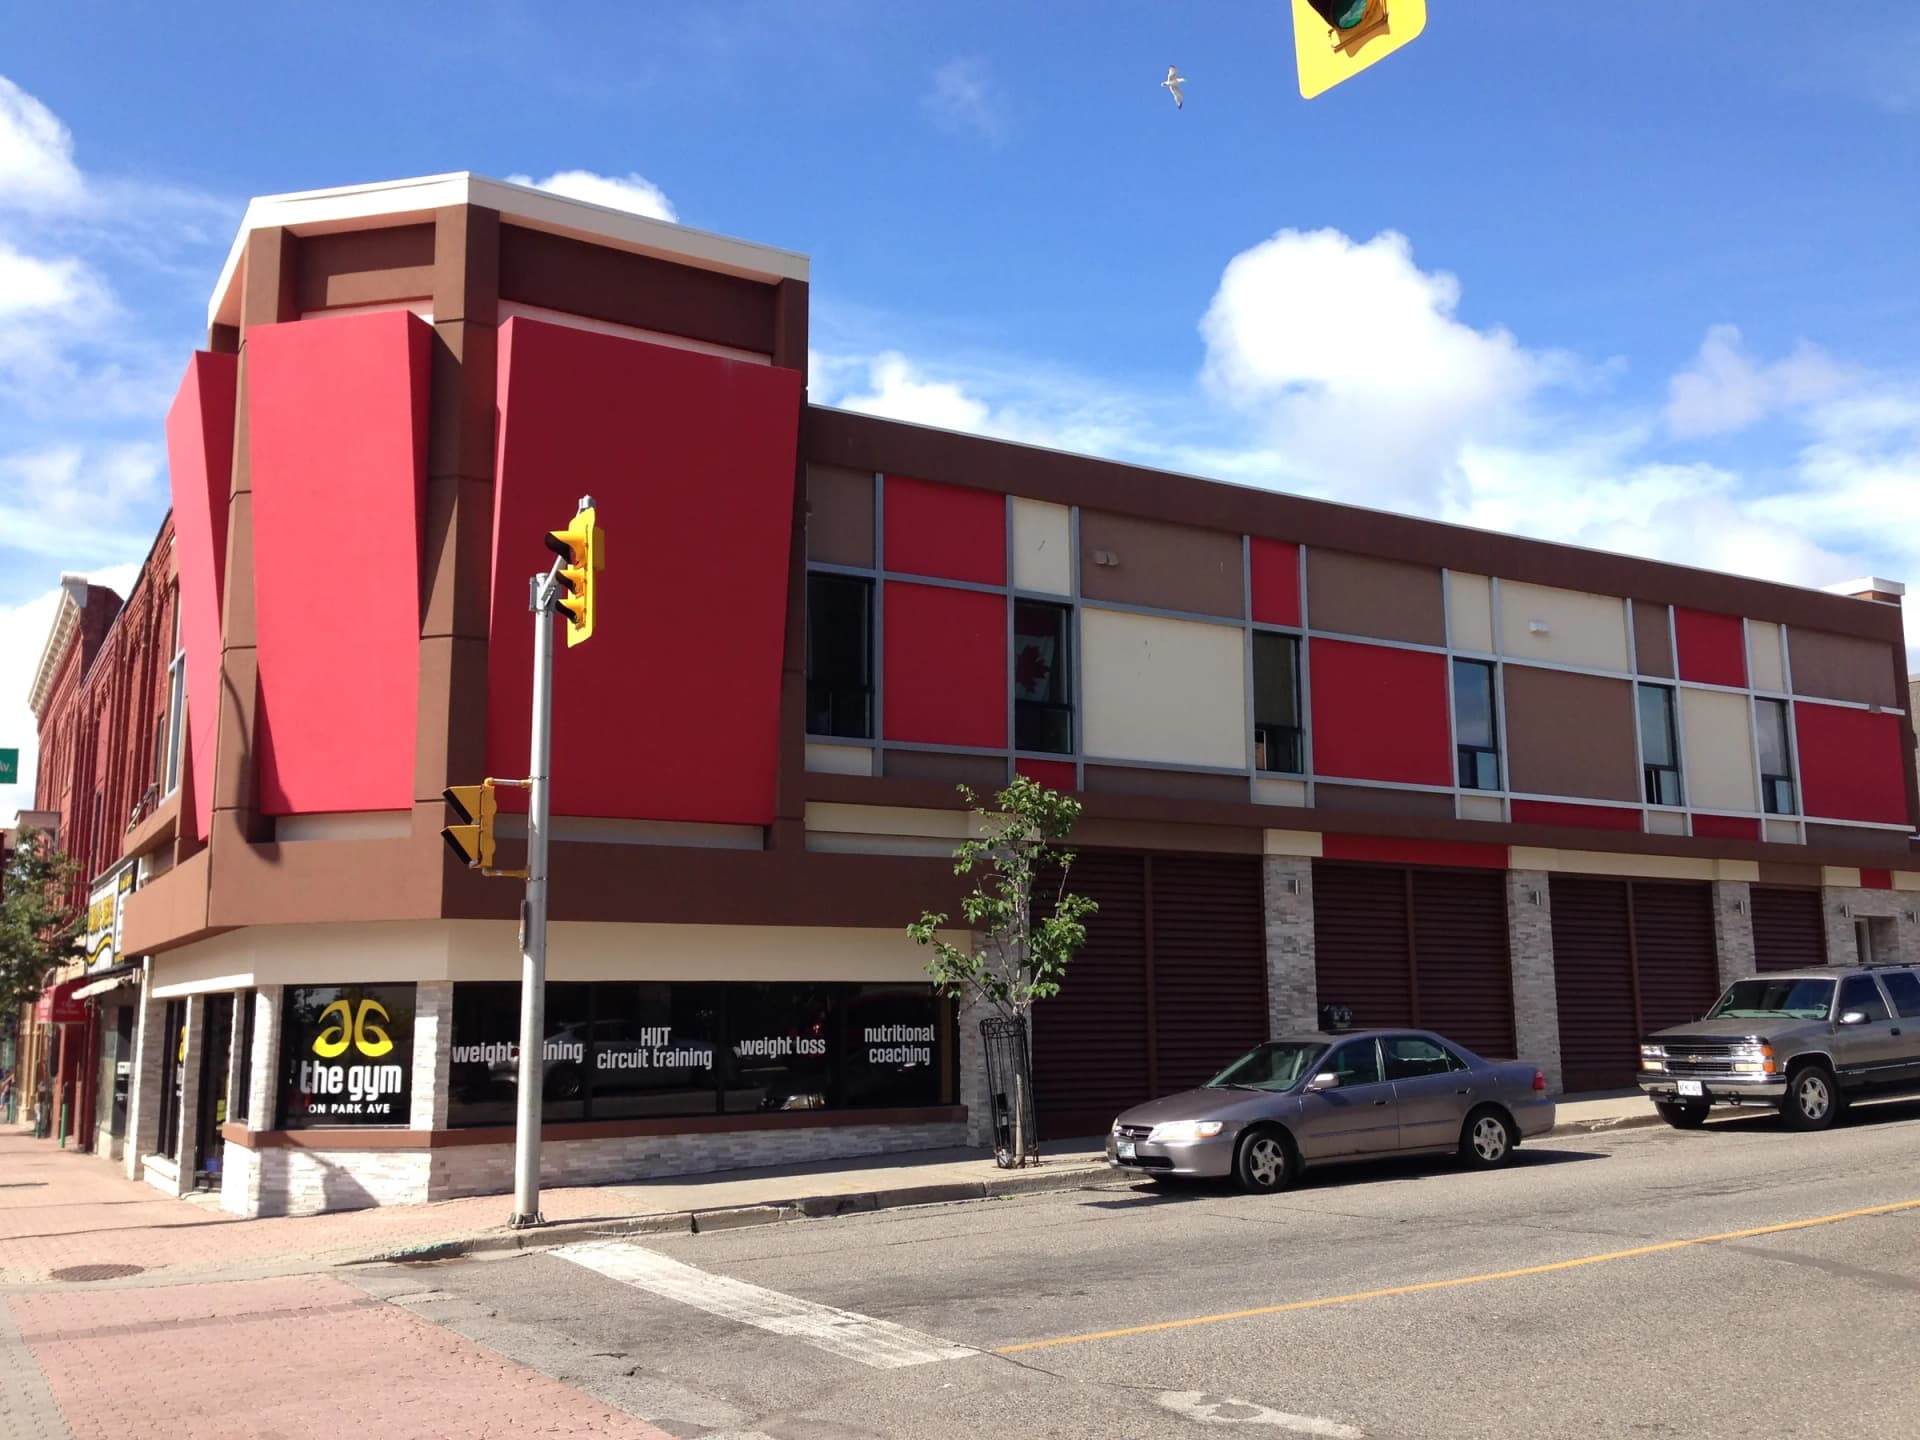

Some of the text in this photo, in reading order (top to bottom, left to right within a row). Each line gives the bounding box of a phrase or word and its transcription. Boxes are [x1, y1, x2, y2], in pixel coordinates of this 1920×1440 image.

[641, 1027, 671, 1046] HIIT
[864, 1025, 935, 1043] nutritional
[452, 1041, 583, 1064] weight ining
[597, 1046, 713, 1070] circuit training
[740, 1036, 826, 1059] weight loss
[869, 1045, 931, 1066] coaching
[300, 1060, 402, 1102] the gym
[308, 1103, 390, 1114] ON PARK AVE
